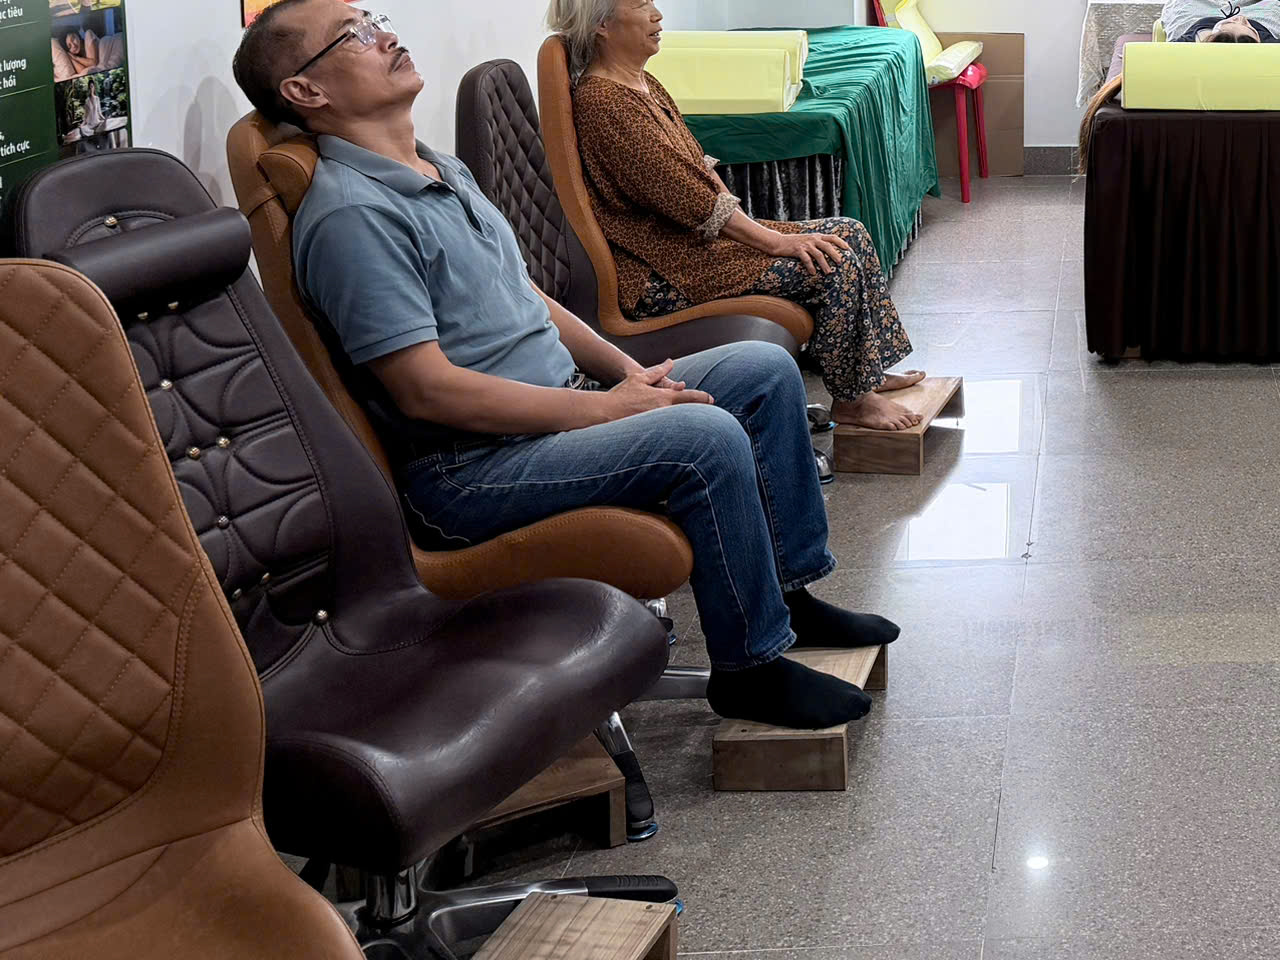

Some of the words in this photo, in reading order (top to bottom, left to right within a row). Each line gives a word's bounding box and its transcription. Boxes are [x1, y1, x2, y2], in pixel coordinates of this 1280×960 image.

[7, 6, 23, 19] tiêu
[3, 58, 27, 73] lượng
[3, 74, 17, 89] hồi
[0, 142, 16, 157] tích
[16, 140, 31, 154] cực
